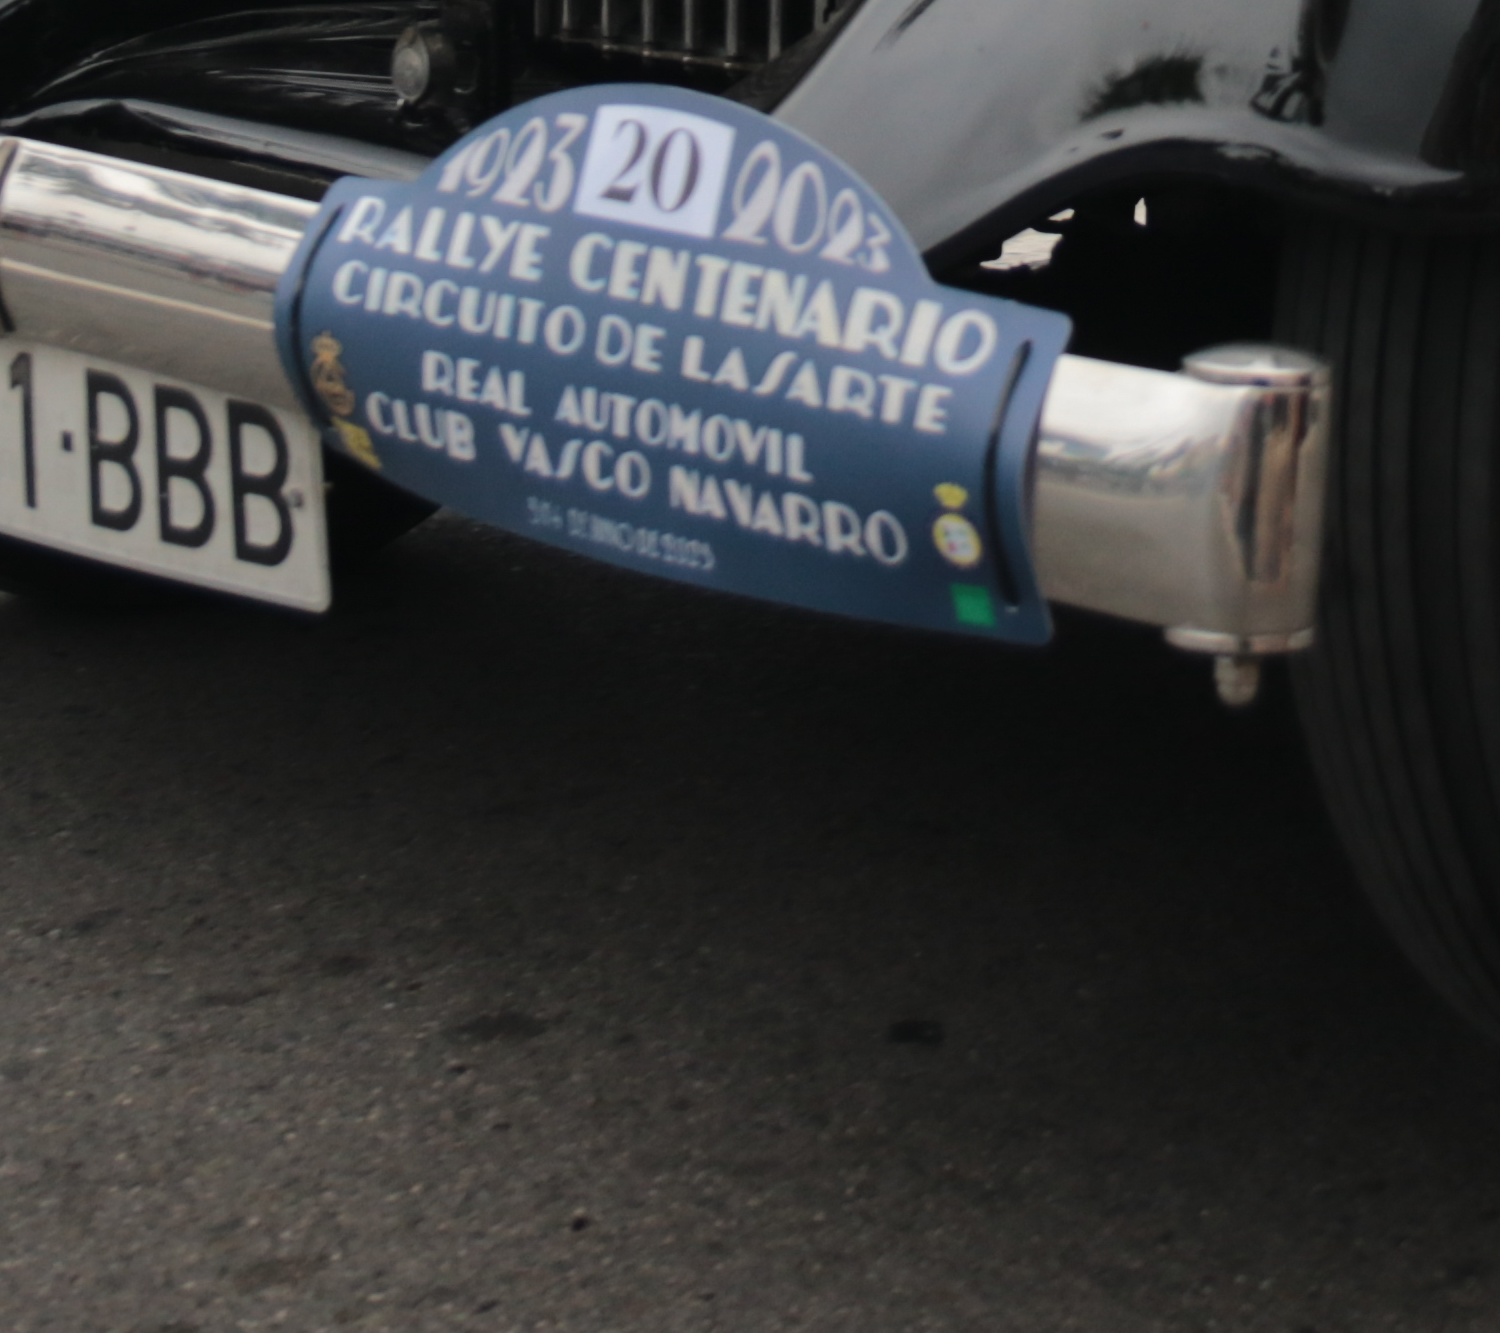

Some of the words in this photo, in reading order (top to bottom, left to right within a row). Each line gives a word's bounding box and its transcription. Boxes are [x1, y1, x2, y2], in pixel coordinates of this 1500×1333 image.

[437, 113, 589, 212] 1923
[597, 119, 703, 212] 20
[720, 140, 893, 273] 2023
[331, 259, 586, 355] CIRCUITO
[595, 314, 667, 373] DE
[336, 196, 551, 281] RALLYE
[569, 233, 998, 375] CENTENARIO
[366, 391, 477, 461] CLUB
[499, 423, 650, 499] VASCO
[669, 464, 908, 565] NAVARRO
[421, 350, 532, 416] REAL
[555, 385, 814, 483] AUTOMOVIL
